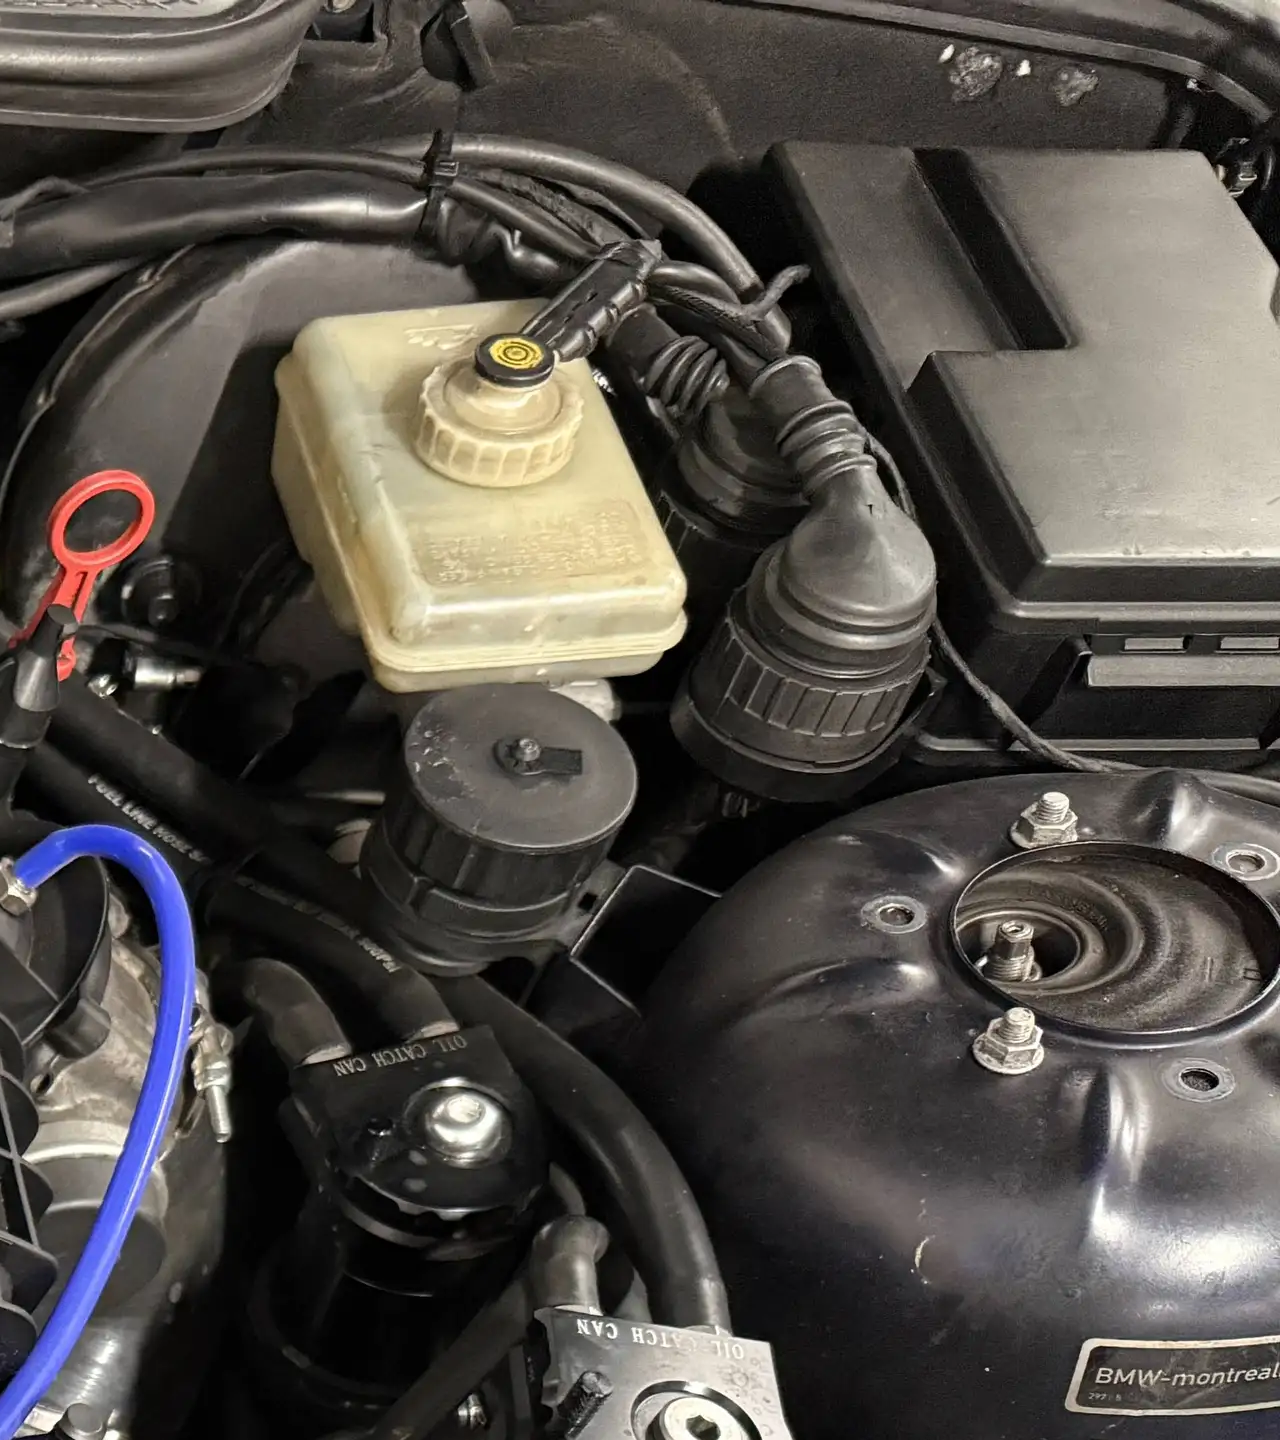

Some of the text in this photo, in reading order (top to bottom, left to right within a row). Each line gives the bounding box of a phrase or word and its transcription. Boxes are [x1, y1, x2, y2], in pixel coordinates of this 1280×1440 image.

[332, 1035, 468, 1077] OIL CATCH CAN
[576, 1319, 619, 1339] CAN
[711, 1340, 745, 1360] OIL
